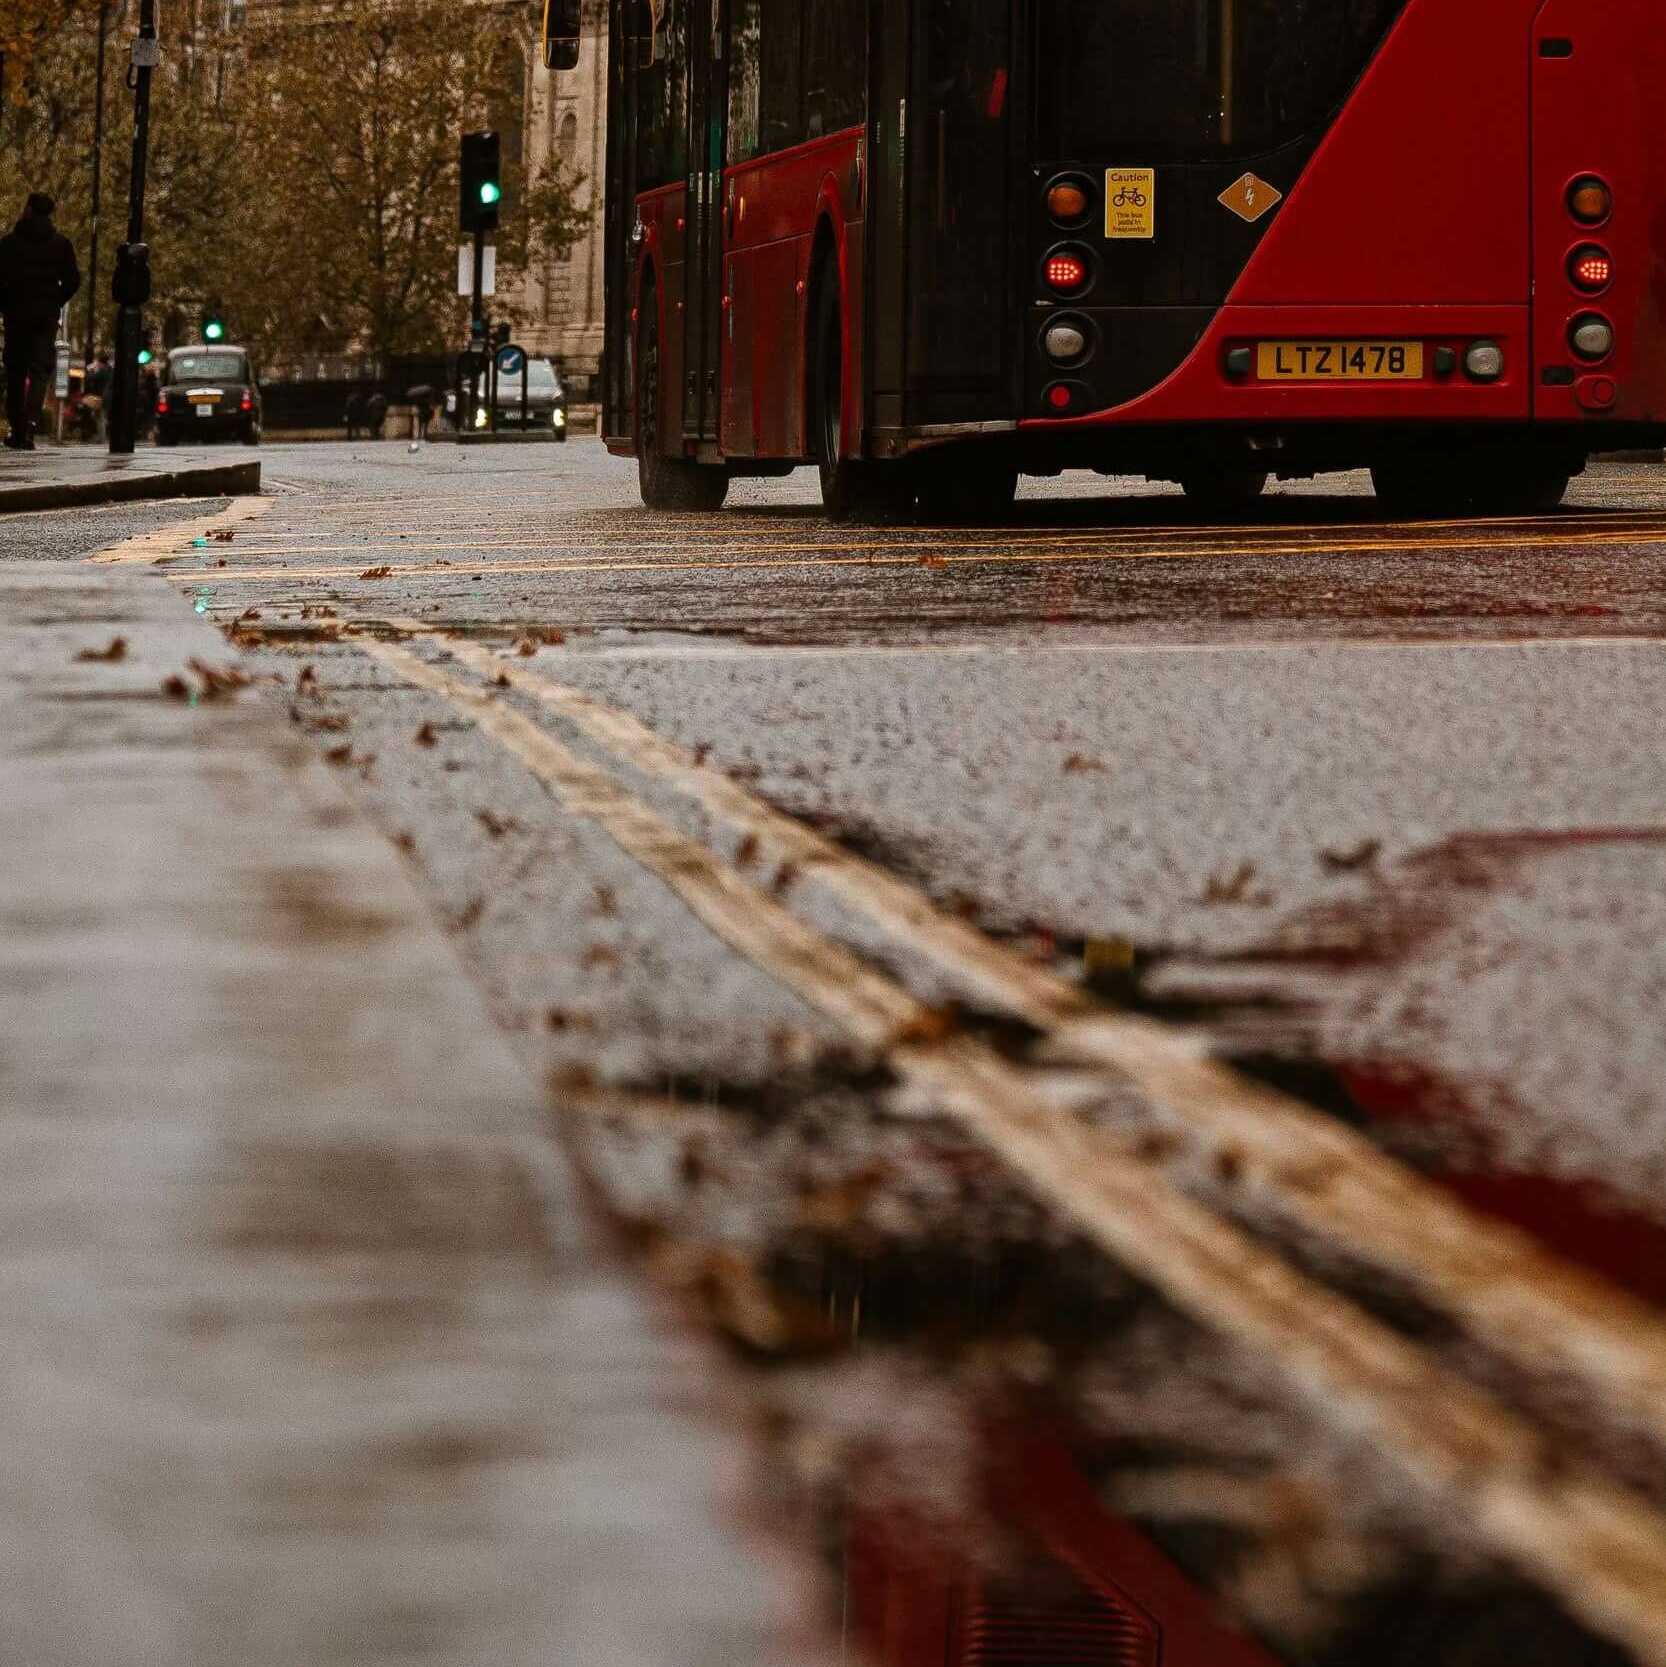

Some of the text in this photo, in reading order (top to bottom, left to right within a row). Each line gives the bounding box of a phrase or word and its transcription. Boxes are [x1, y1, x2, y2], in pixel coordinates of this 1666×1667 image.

[1111, 173, 1149, 182] Caution
[1276, 346, 1405, 374] LTZ 1478
